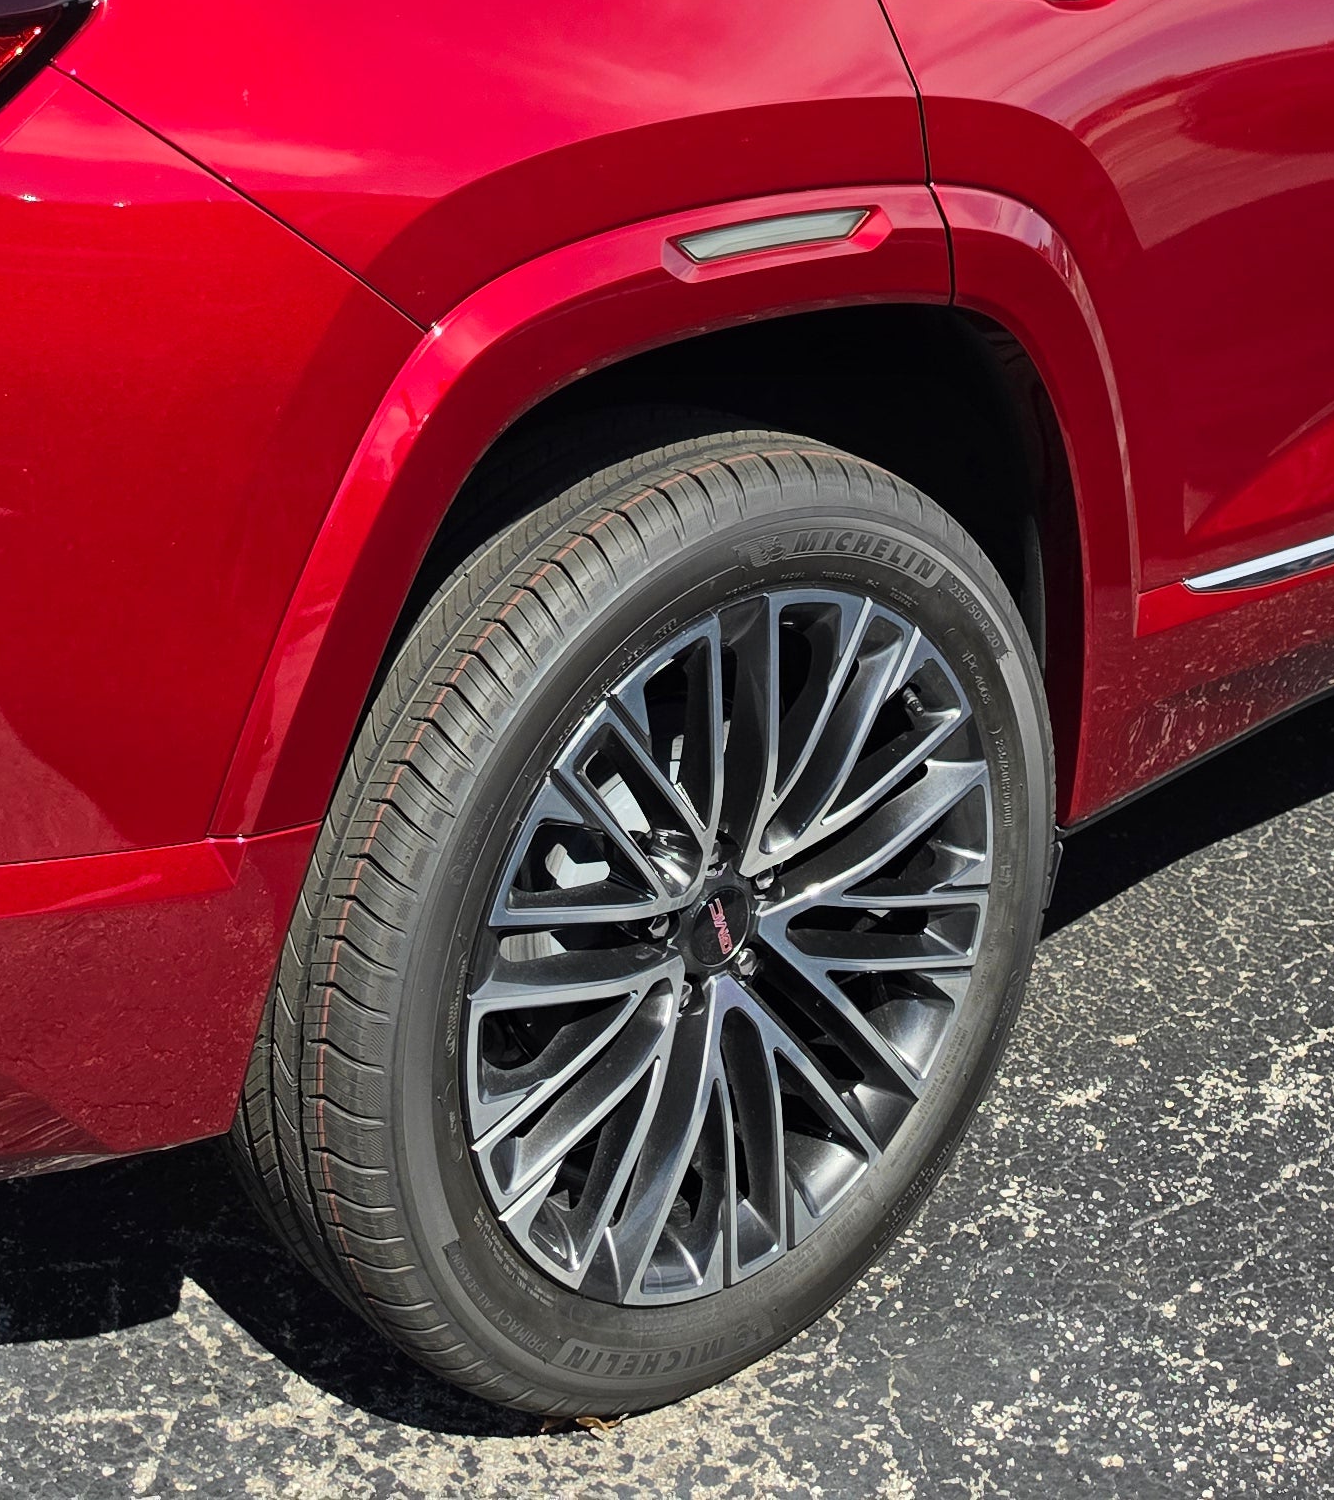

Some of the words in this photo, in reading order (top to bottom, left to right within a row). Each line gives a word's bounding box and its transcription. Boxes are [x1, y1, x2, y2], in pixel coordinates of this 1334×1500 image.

[793, 531, 937, 581] MICHELIN
[948, 583, 983, 620] 235/50
[979, 622, 991, 632] R
[986, 632, 1001, 648] 20
[708, 898, 733, 954] GMC
[451, 1253, 480, 1293] SEASON
[476, 1292, 495, 1309] ALL
[491, 1308, 548, 1353] PRIMACY
[563, 1336, 725, 1376] MICHELIN
